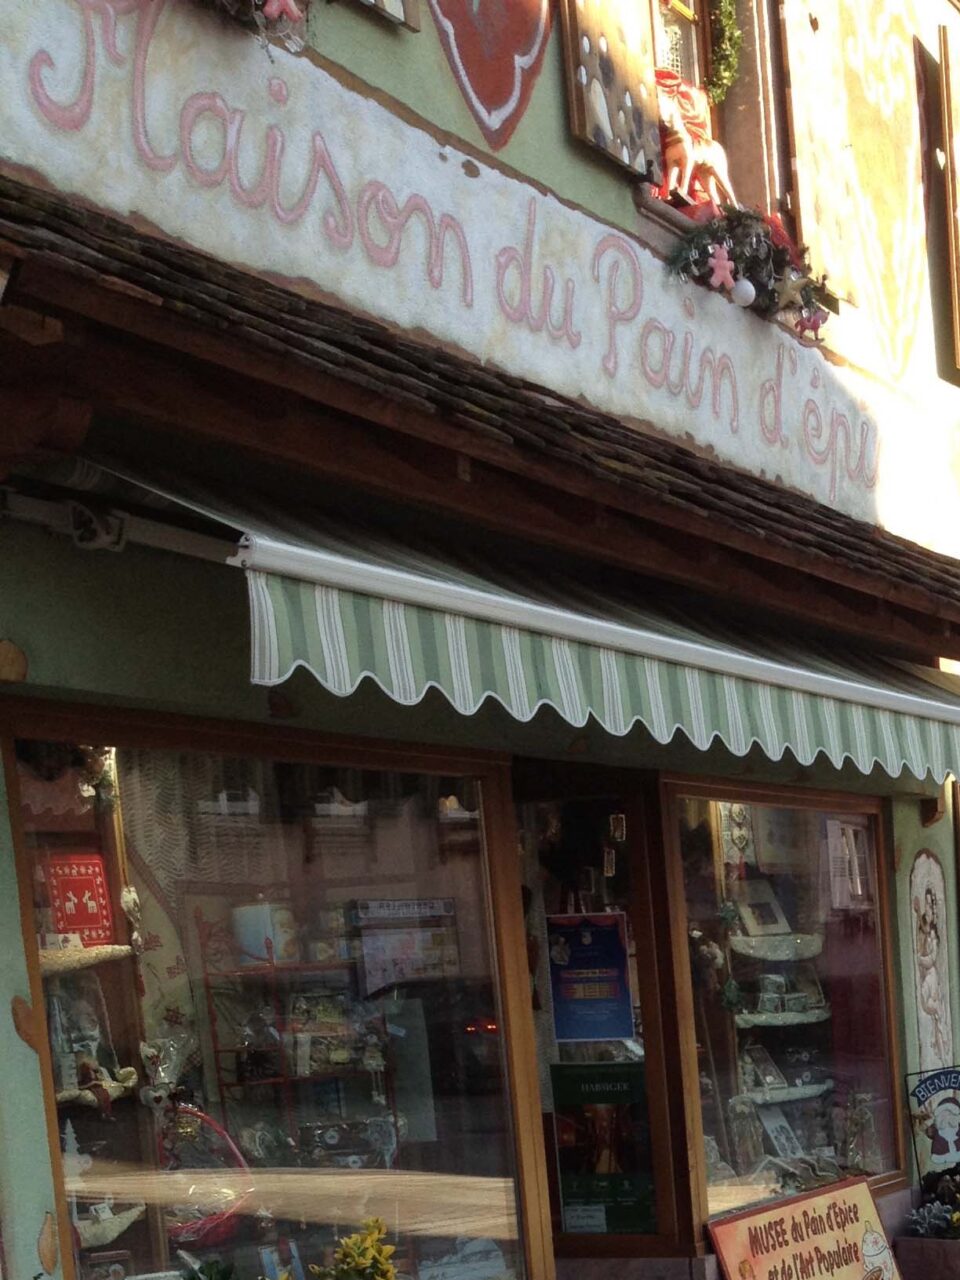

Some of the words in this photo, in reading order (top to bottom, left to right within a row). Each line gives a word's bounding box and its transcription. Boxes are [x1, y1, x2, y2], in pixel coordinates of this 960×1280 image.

[28, 0, 474, 307] Maison
[495, 196, 582, 350] du
[592, 233, 740, 436] Pain
[748, 1217, 789, 1258] MUSEE
[791, 1215, 805, 1243] du
[802, 1207, 826, 1239] Pain
[814, 1238, 860, 1277] Populaire
